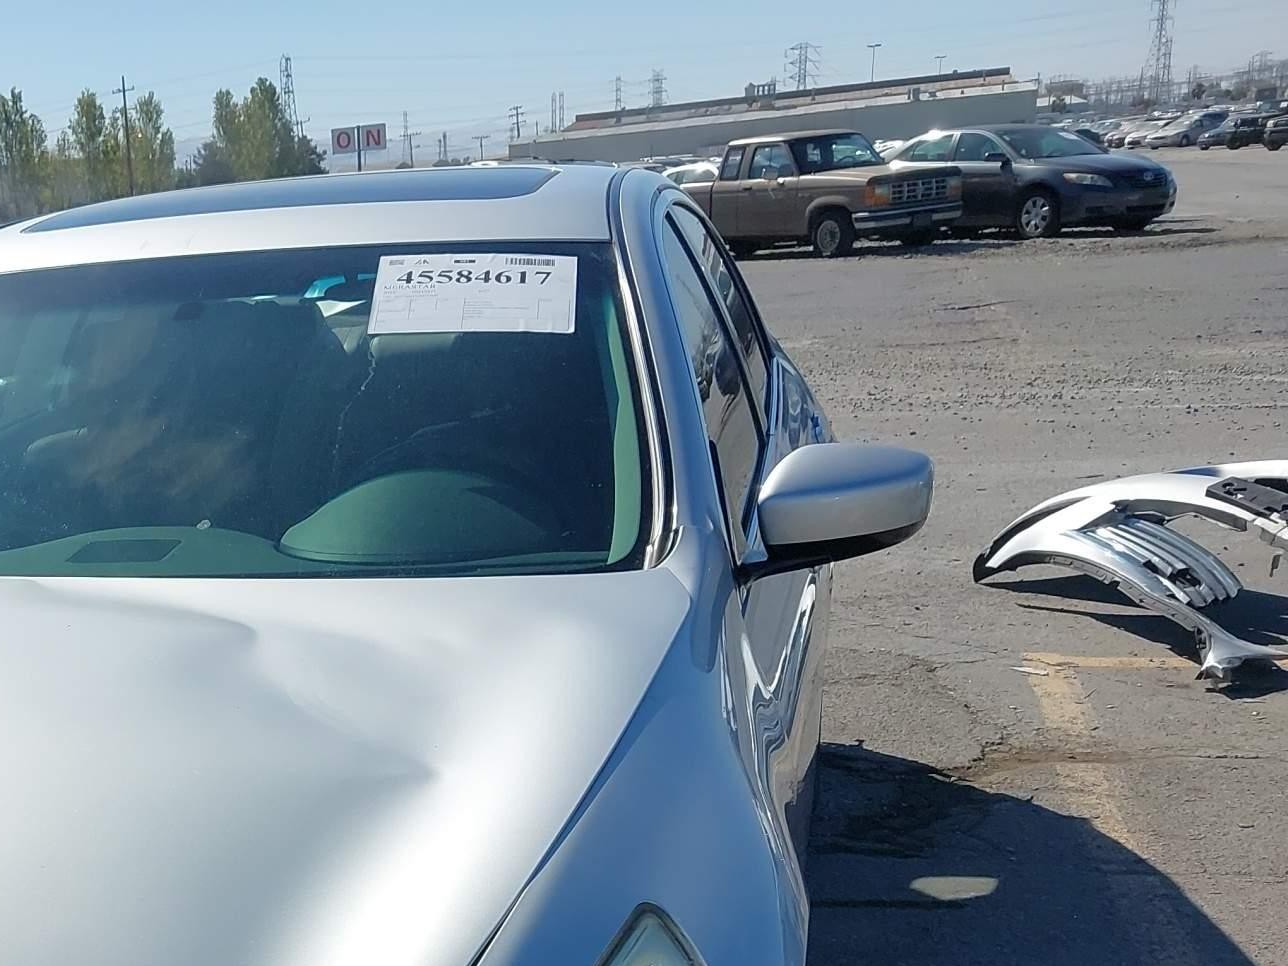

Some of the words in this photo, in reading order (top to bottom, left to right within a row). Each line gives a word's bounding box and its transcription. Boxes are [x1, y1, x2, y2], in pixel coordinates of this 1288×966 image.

[336, 131, 352, 150] O
[366, 128, 382, 147] N
[396, 269, 553, 286] 45584617
